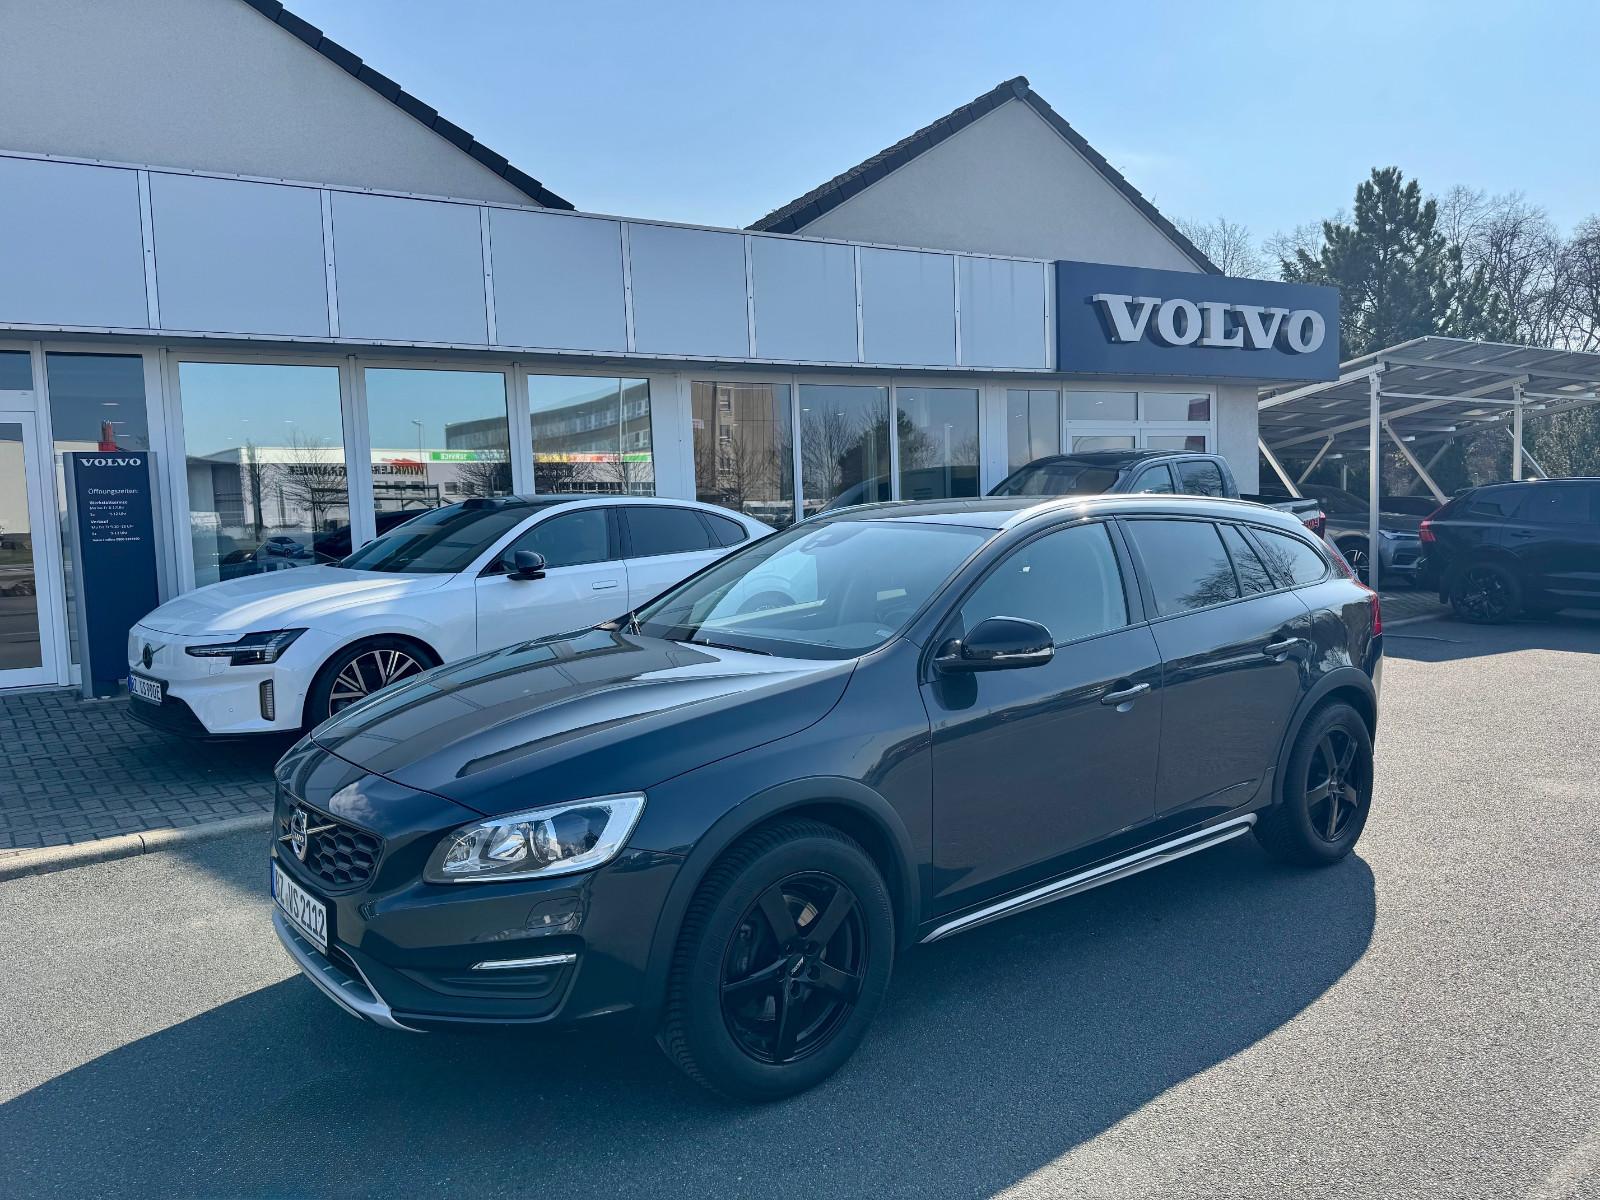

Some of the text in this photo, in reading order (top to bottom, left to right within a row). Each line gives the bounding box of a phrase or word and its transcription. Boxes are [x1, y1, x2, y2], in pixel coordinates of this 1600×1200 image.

[1092, 293, 1326, 354] VOLVO
[80, 458, 142, 467] VOLVO
[287, 882, 300, 919] VS
[300, 893, 326, 942] 2112
